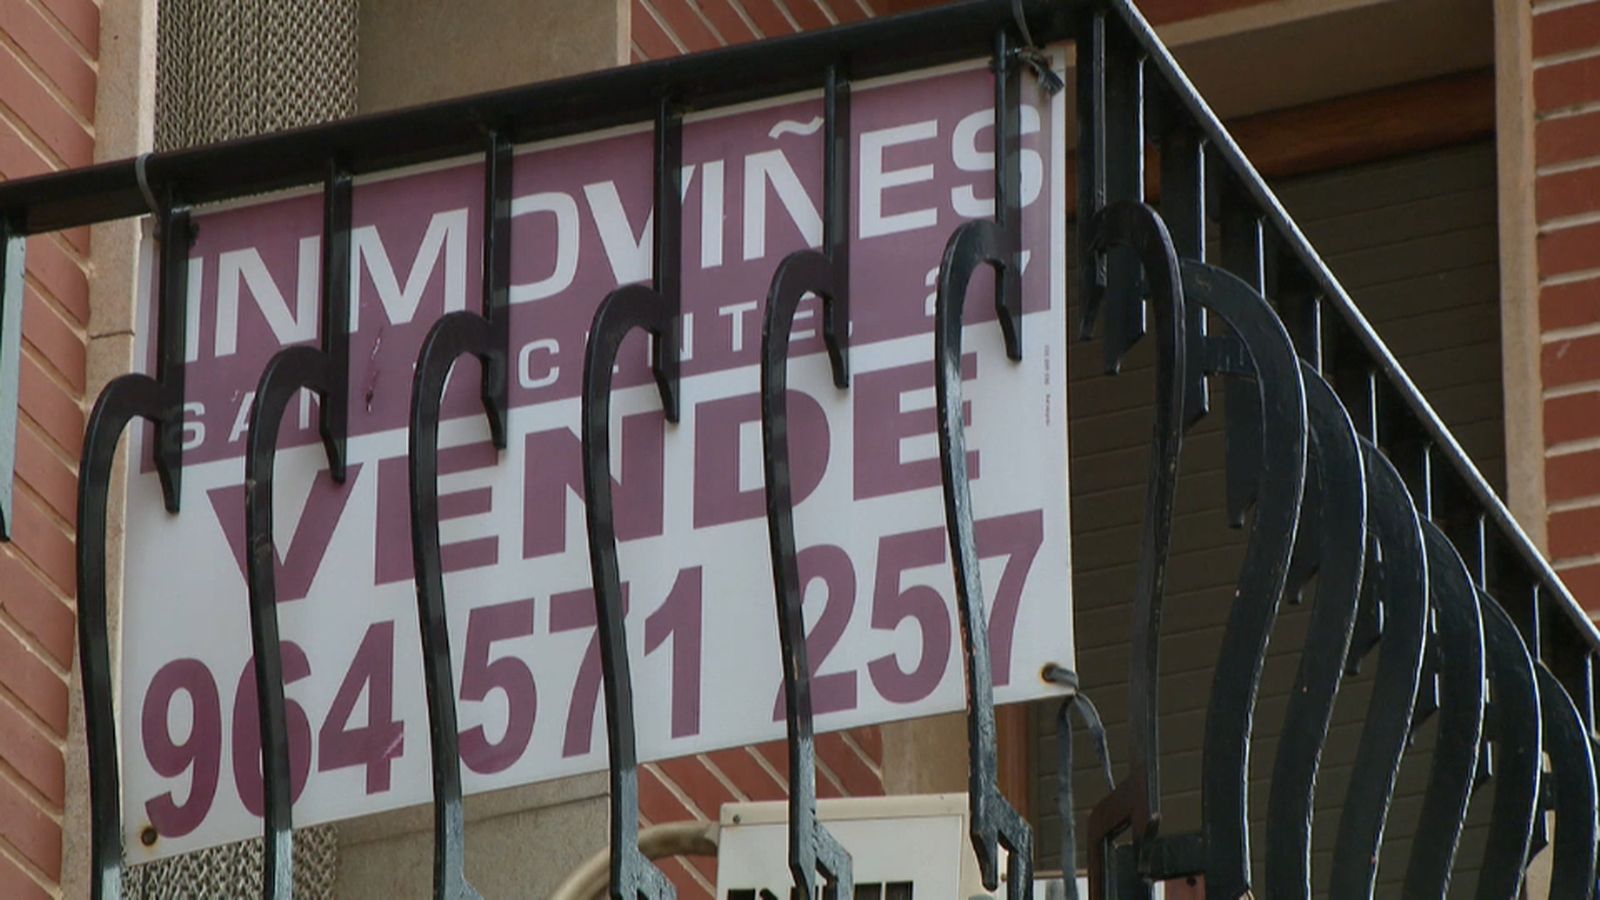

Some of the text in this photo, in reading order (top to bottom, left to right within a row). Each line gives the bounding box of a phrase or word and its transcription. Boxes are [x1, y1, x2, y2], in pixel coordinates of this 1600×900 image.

[186, 102, 1043, 363] INMOVIÑES
[206, 351, 980, 604] VENDE
[141, 508, 1044, 839] 964 571 257
